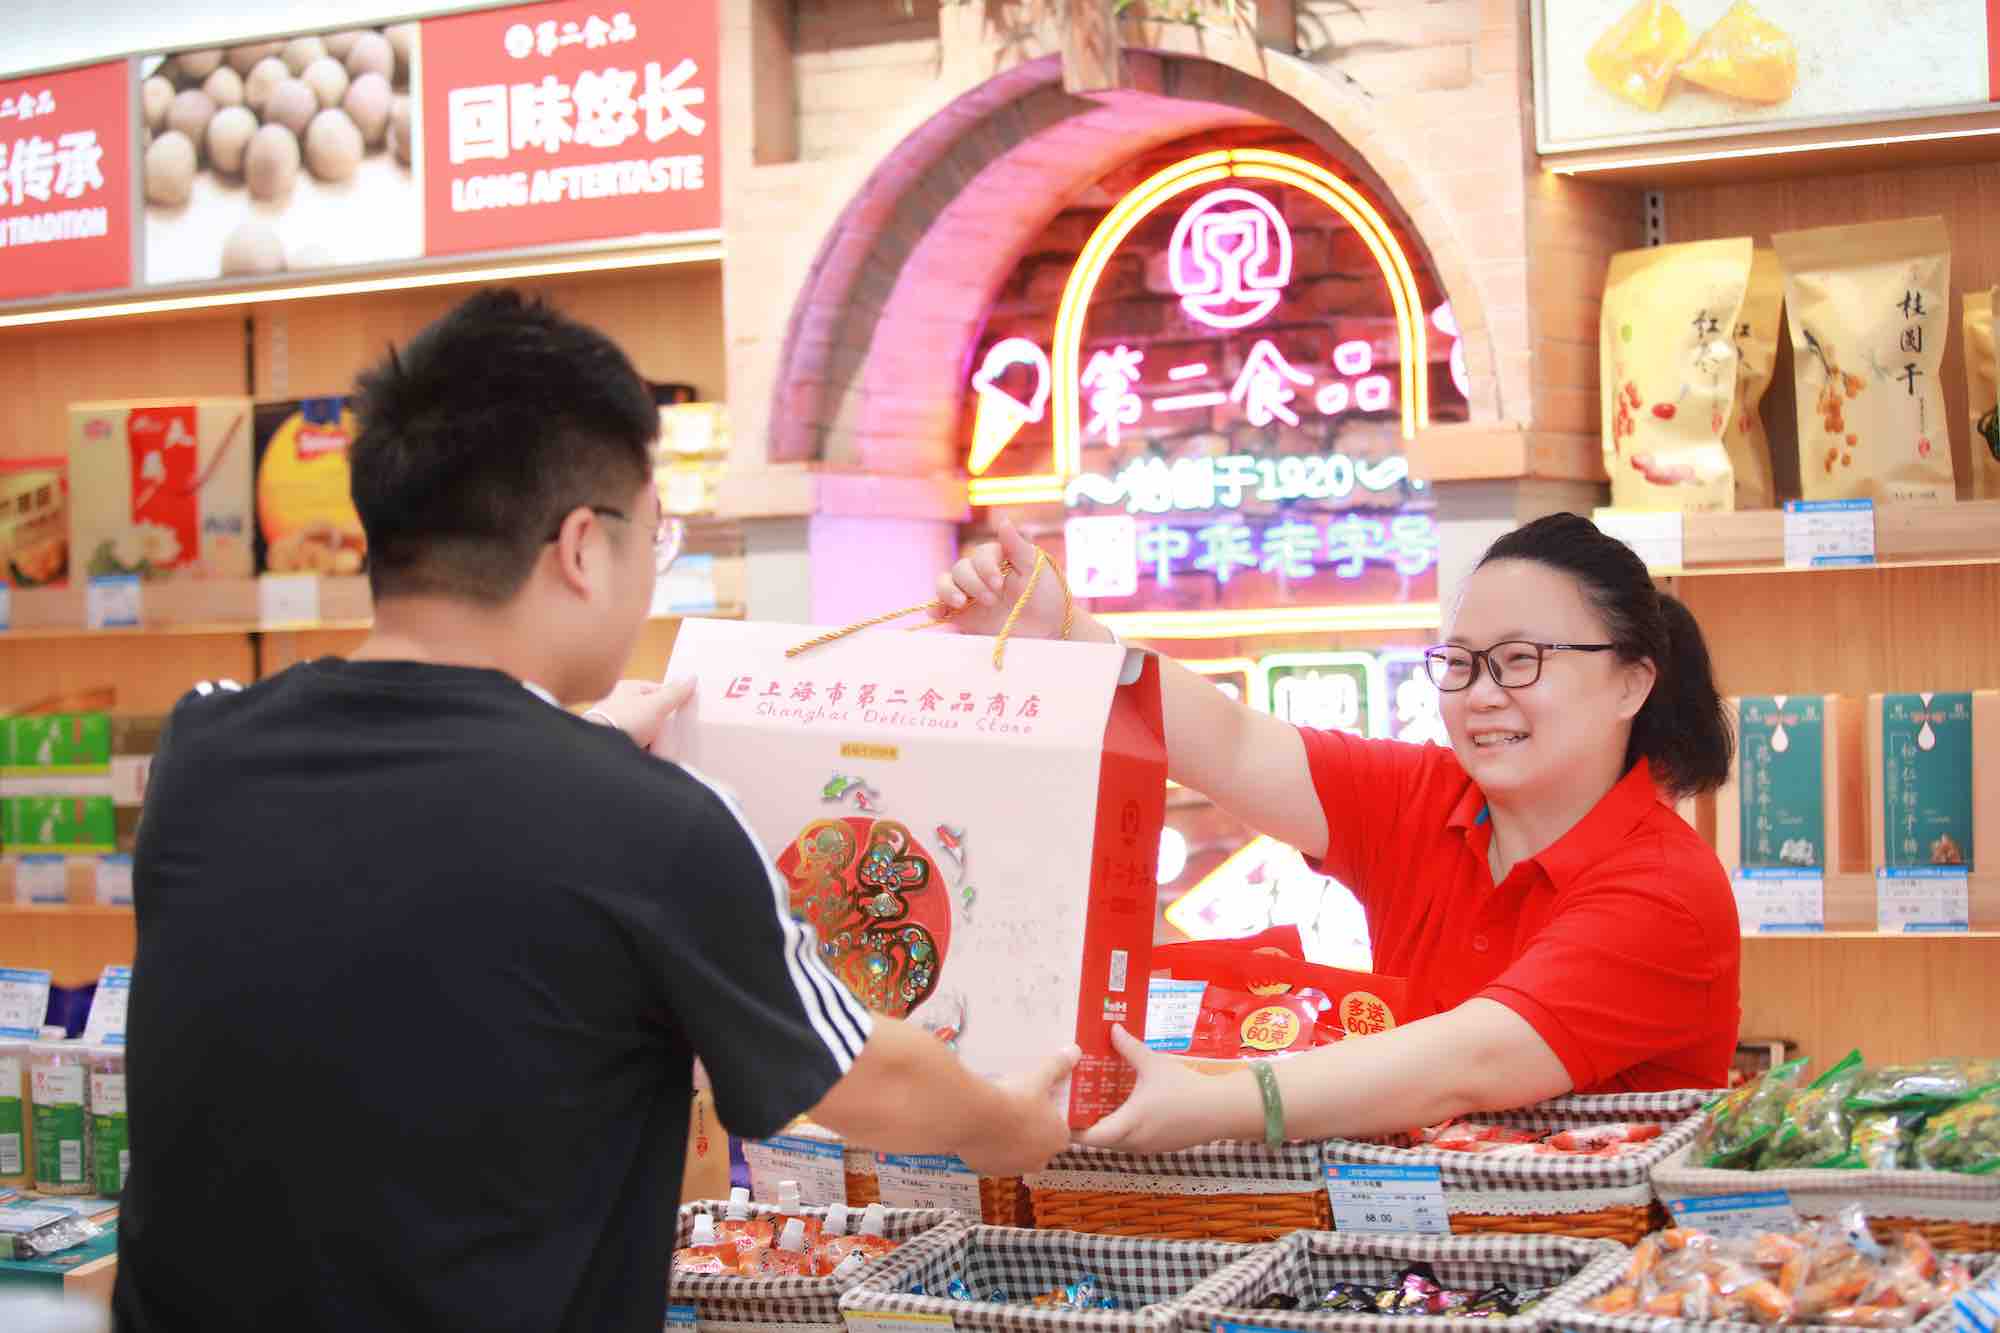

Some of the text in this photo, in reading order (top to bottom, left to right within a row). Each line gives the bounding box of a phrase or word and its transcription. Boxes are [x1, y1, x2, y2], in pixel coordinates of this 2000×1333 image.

[448, 58, 706, 165] 回味悠长
[0, 129, 104, 206] 传承
[451, 154, 704, 212] LONG AFTERTASTE
[1896, 289, 1927, 396] 桂圆干
[1081, 339, 1391, 447] 第二食品
[1136, 513, 1440, 588] 中华老字号
[754, 701, 849, 725] Shanghai
[759, 680, 1041, 719] 上海市第二食品商店
